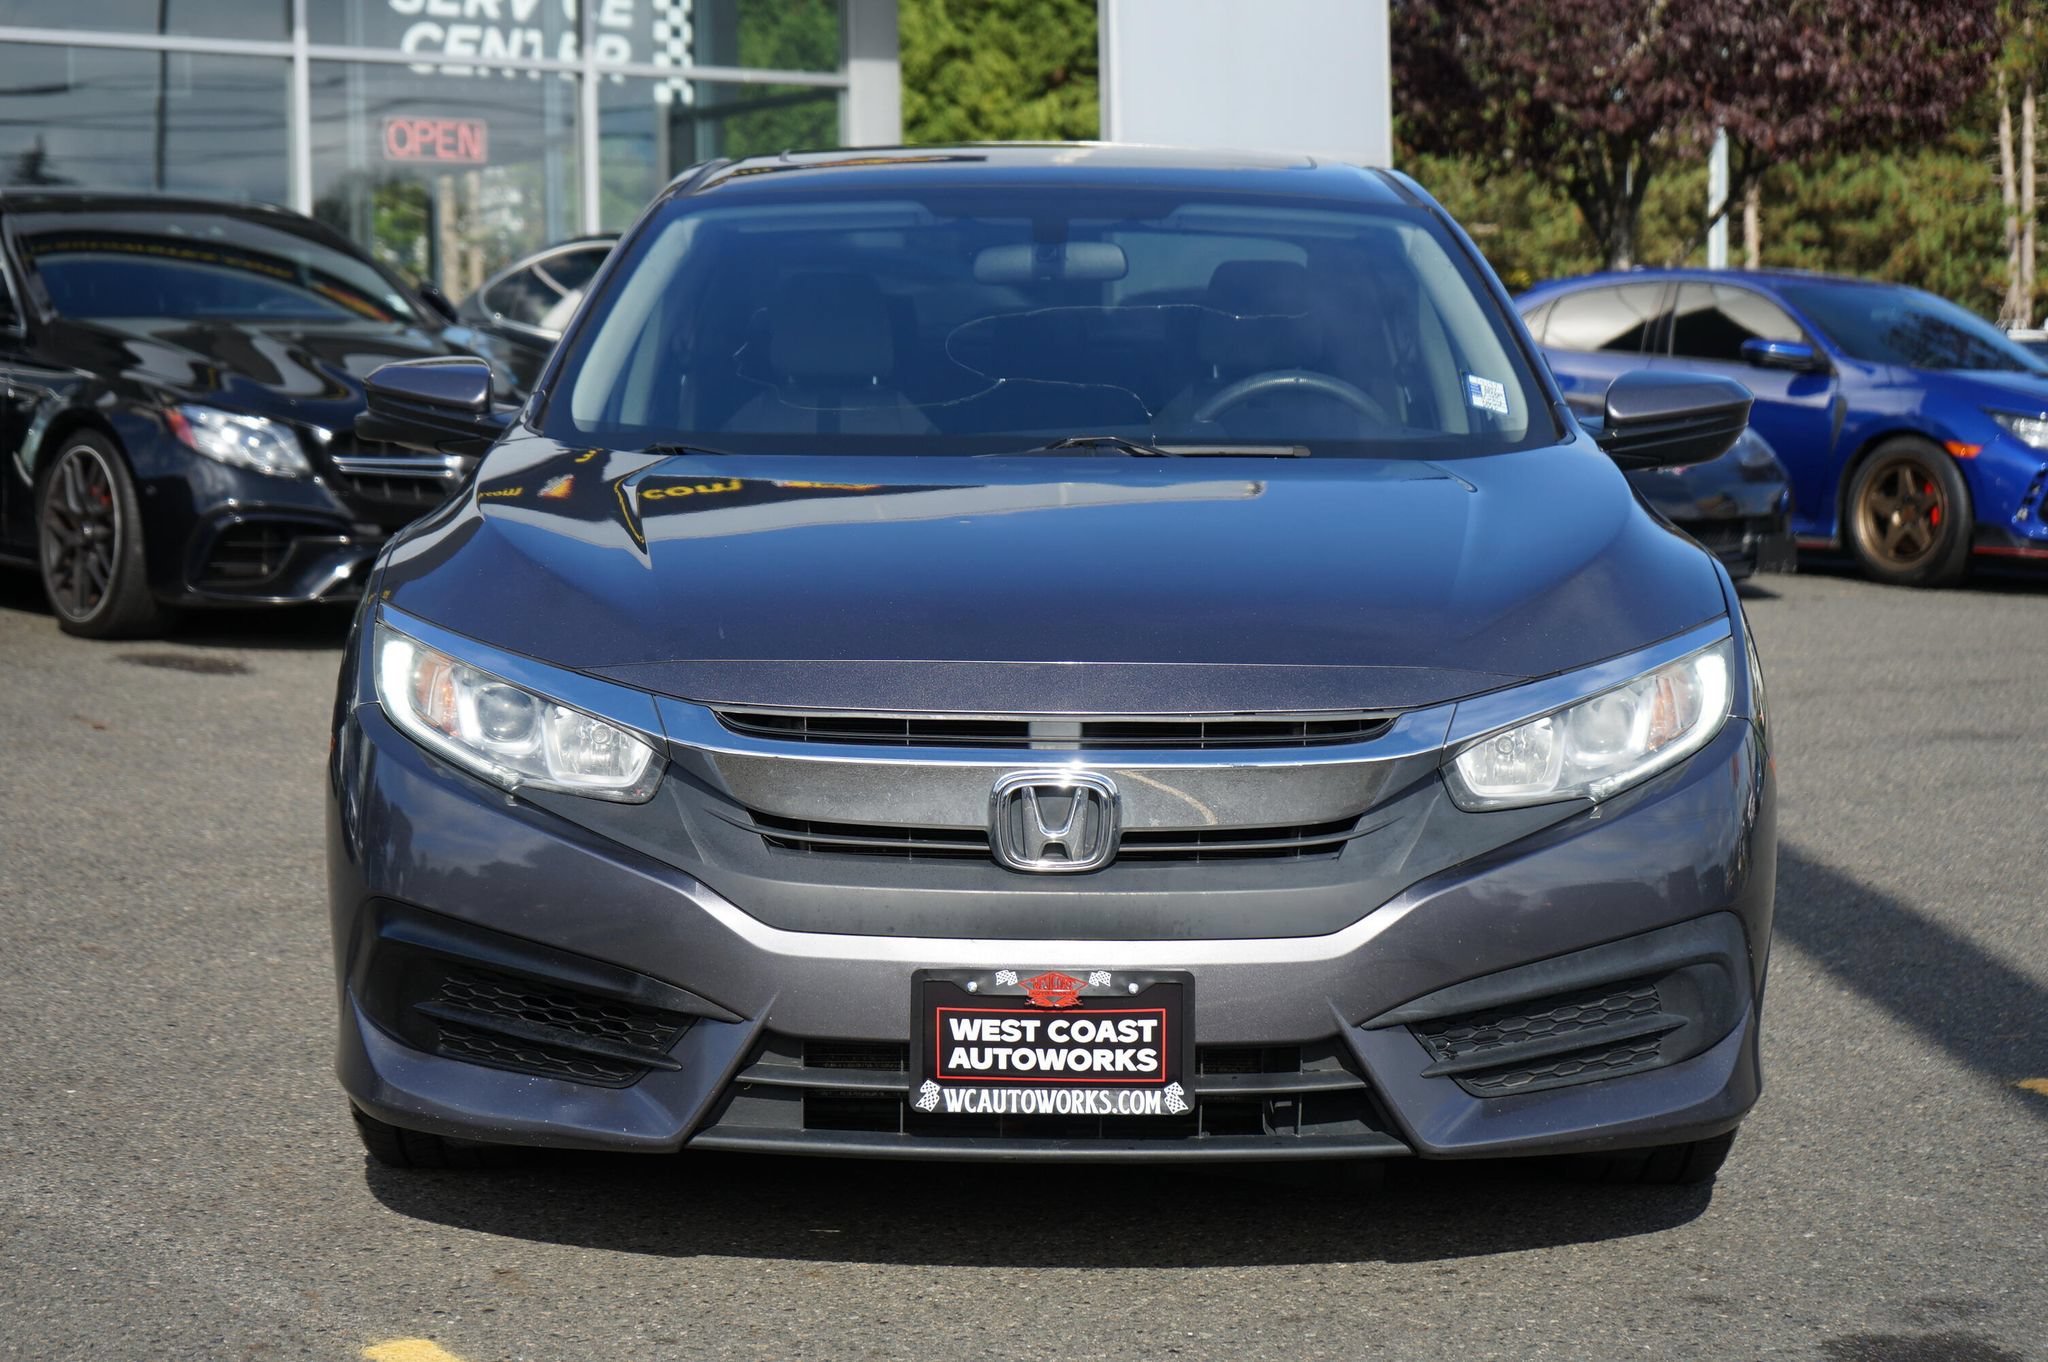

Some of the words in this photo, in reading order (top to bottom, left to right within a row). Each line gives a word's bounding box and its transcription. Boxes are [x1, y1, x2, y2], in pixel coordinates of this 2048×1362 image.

[387, 120, 482, 159] OPEN
[949, 1018, 1041, 1042] WEST
[1047, 1019, 1158, 1043] COAST
[948, 1047, 1158, 1072] AUTOWORKS
[943, 1088, 1162, 1115] WCAUTOWORKS.COM
